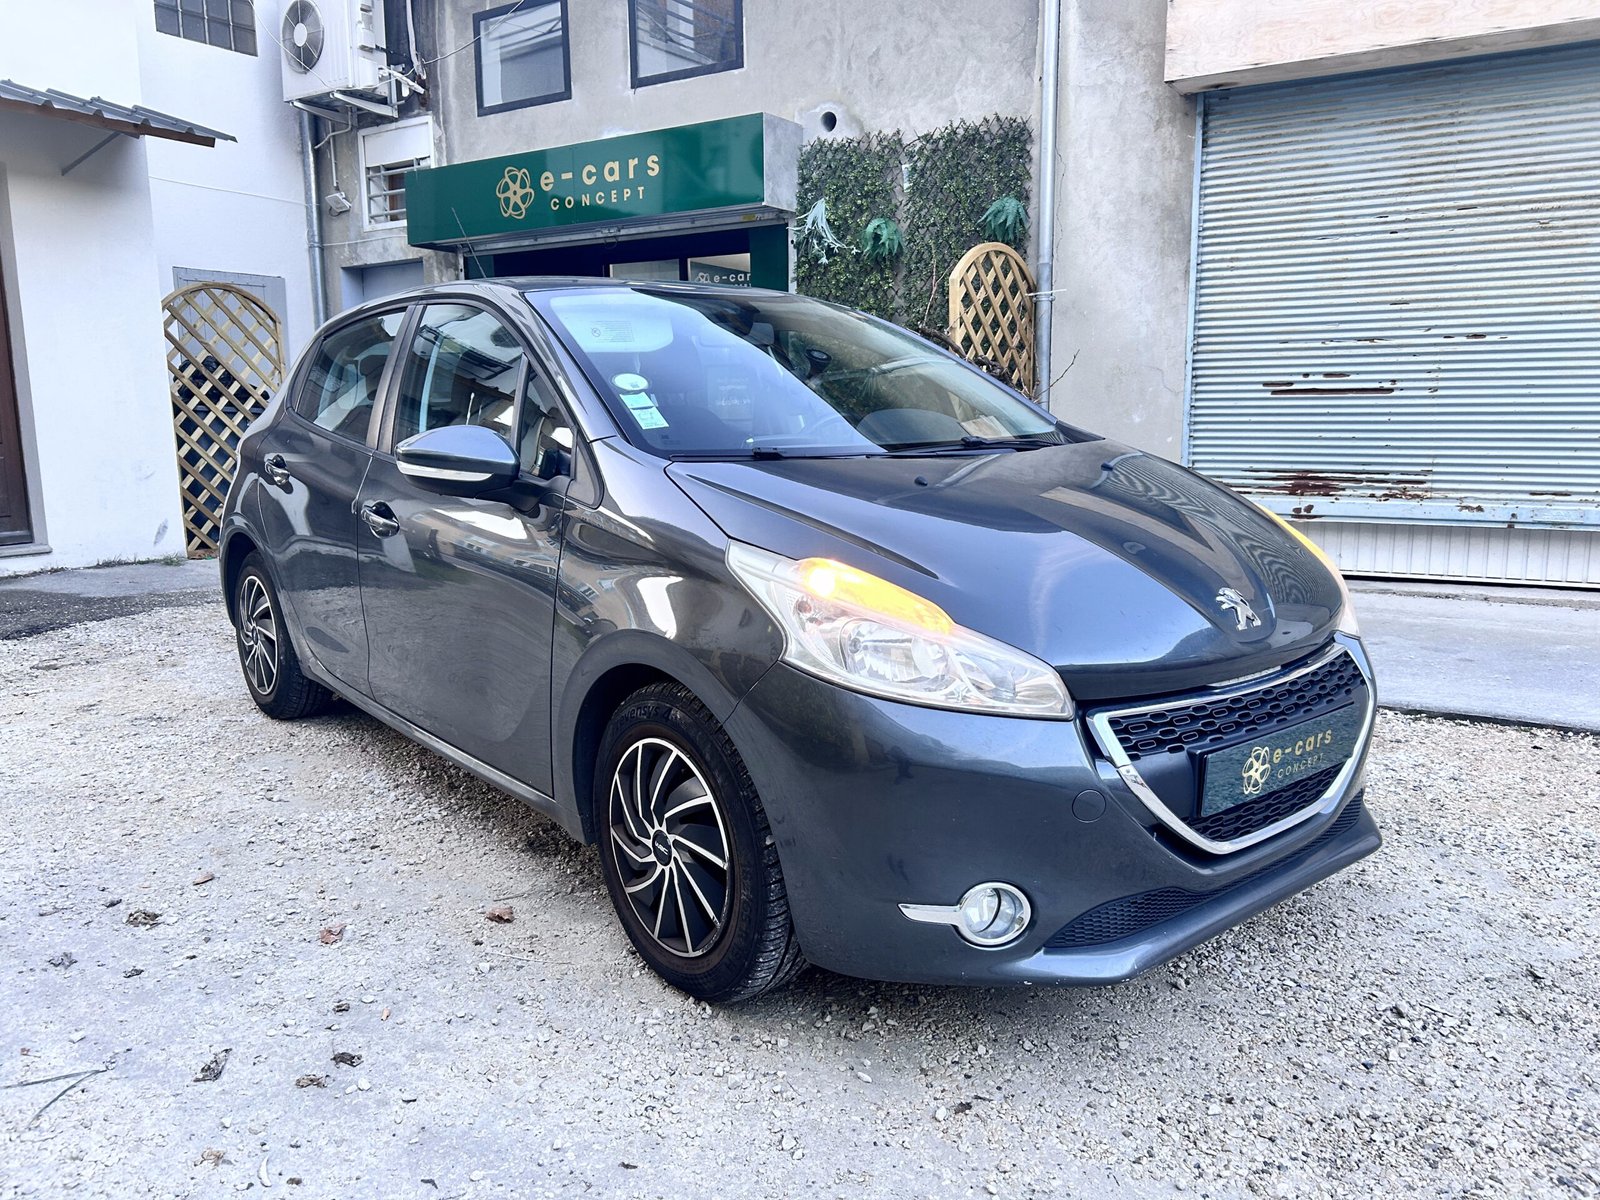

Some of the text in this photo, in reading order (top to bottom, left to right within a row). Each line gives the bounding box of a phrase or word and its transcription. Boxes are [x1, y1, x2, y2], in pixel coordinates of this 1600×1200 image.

[540, 154, 661, 192] e-cars
[550, 186, 645, 211] CONCEPT
[1272, 729, 1332, 764] e-cars
[1277, 753, 1324, 779] CONCEPT
